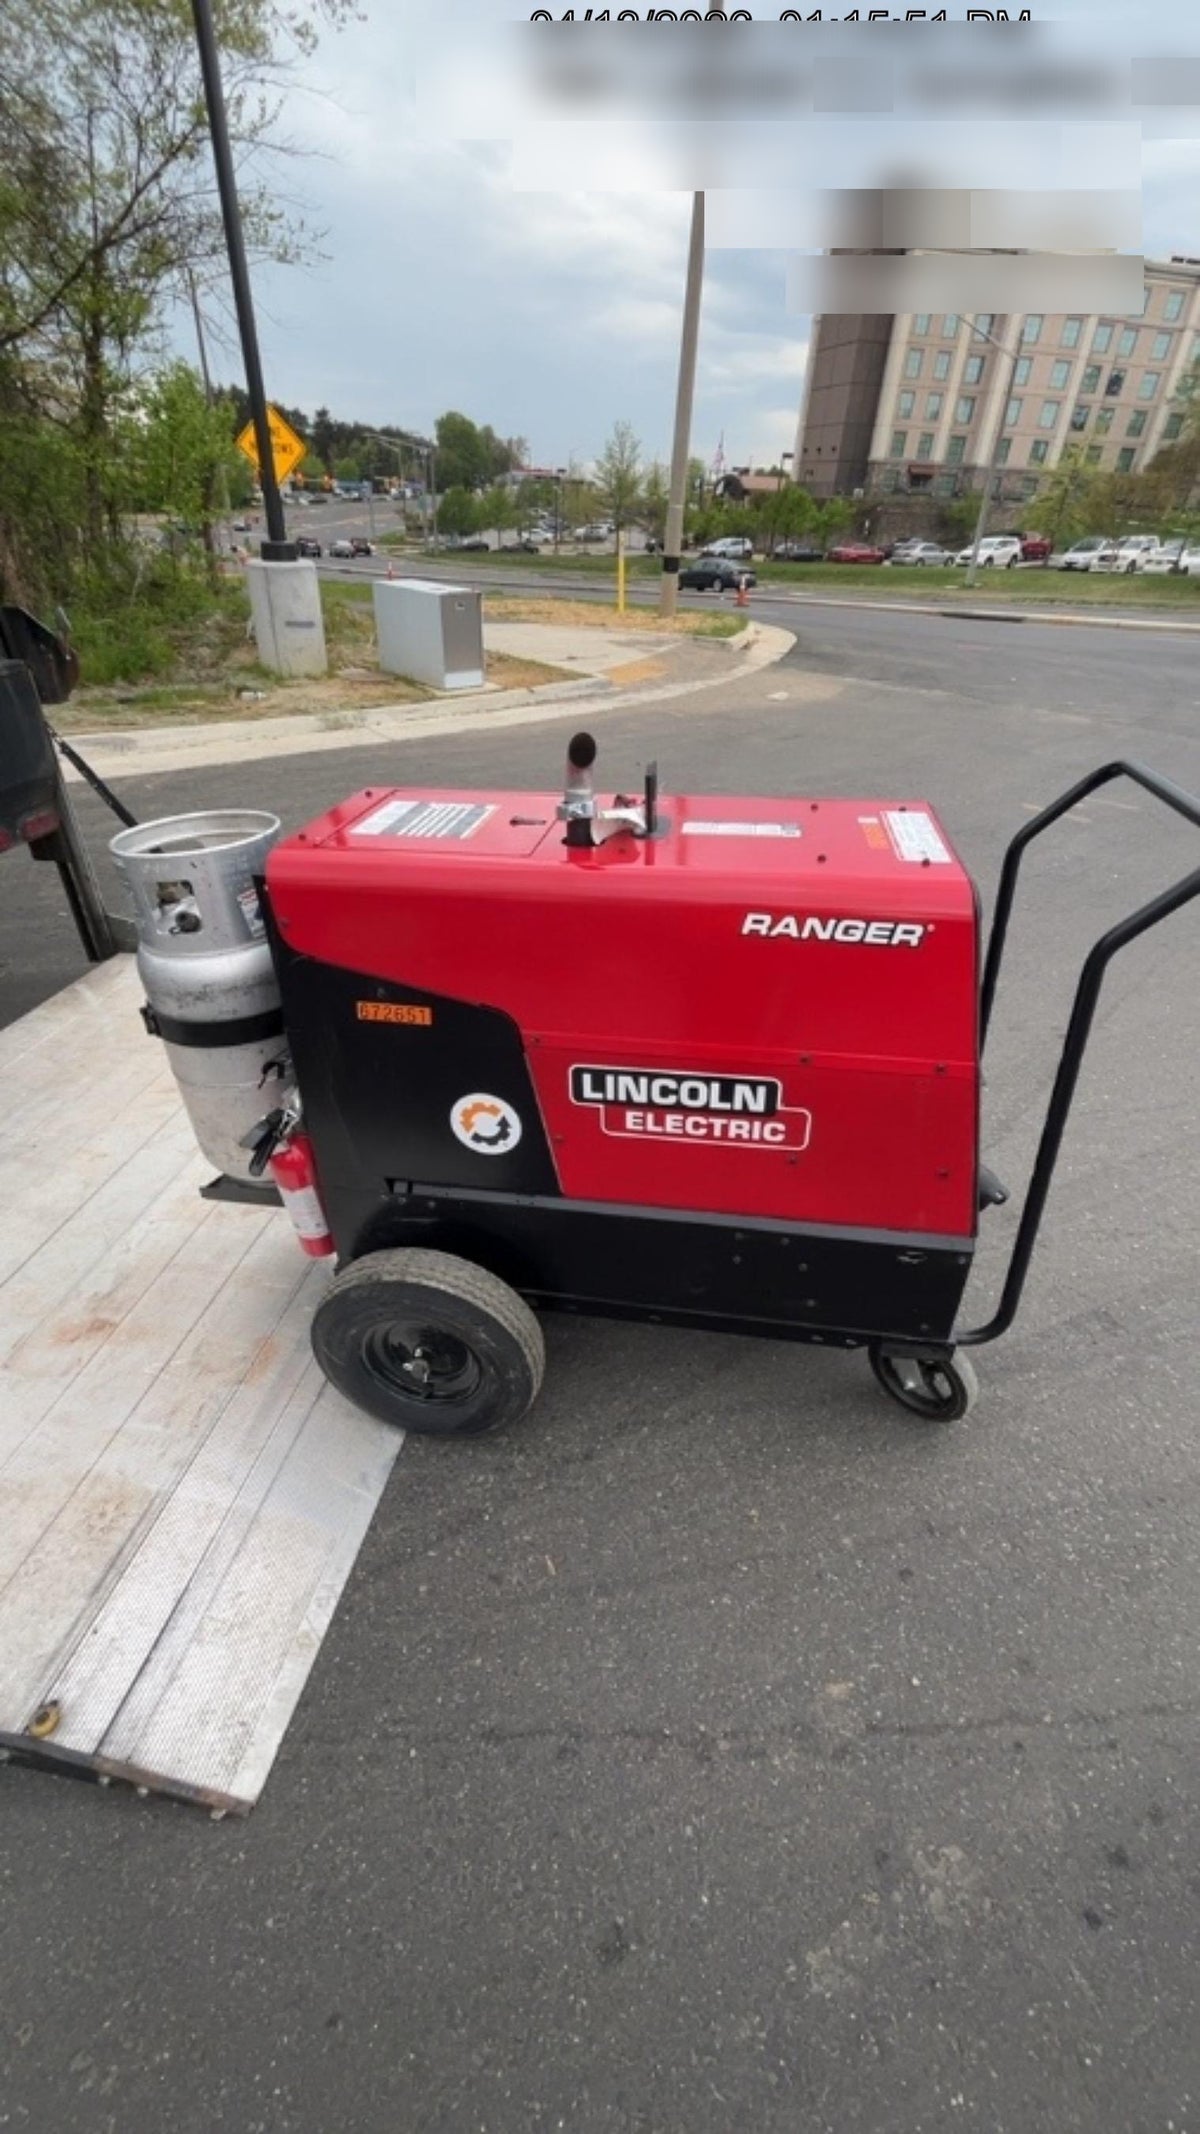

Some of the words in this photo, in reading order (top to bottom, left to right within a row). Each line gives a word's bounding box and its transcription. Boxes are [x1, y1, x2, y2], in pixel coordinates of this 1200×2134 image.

[741, 912, 924, 947] RANGER
[582, 1072, 767, 1113] LINCOLN
[625, 1111, 786, 1142] ELECTRIC
